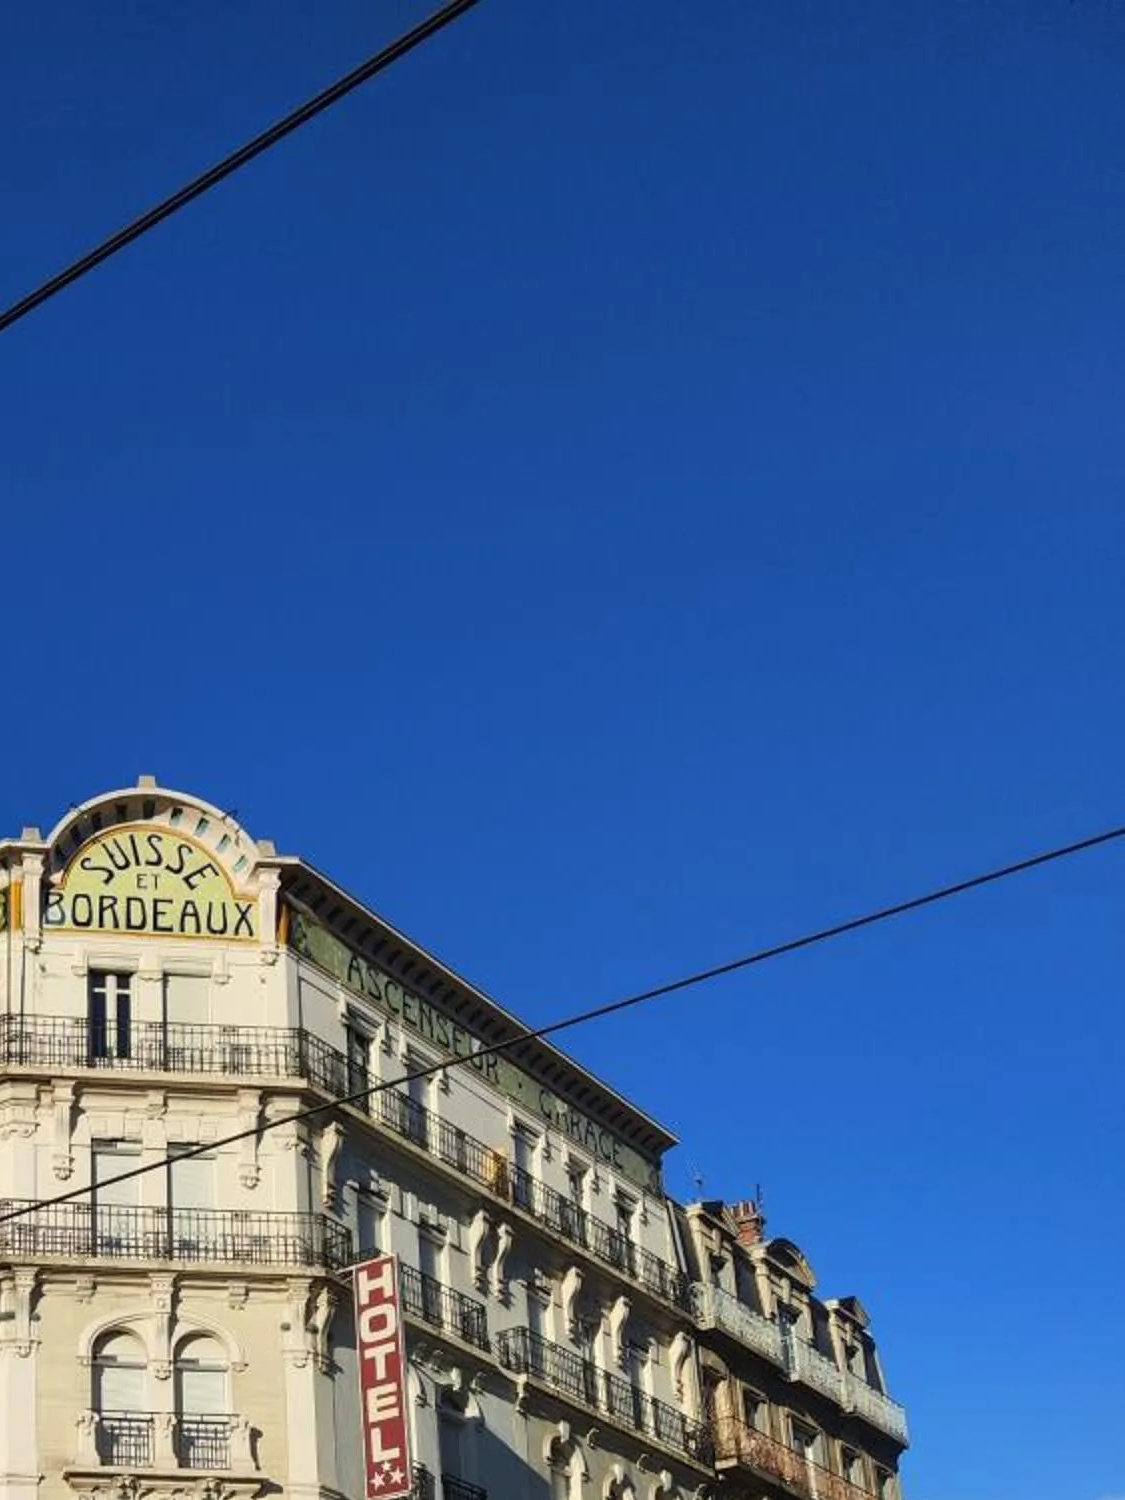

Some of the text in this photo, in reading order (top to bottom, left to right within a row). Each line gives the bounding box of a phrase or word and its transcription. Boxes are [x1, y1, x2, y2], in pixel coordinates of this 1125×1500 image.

[80, 833, 220, 891] SUISSE
[136, 873, 161, 890] ET
[43, 889, 255, 937] BORDEAUX
[358, 1262, 401, 1464] HOTEL
